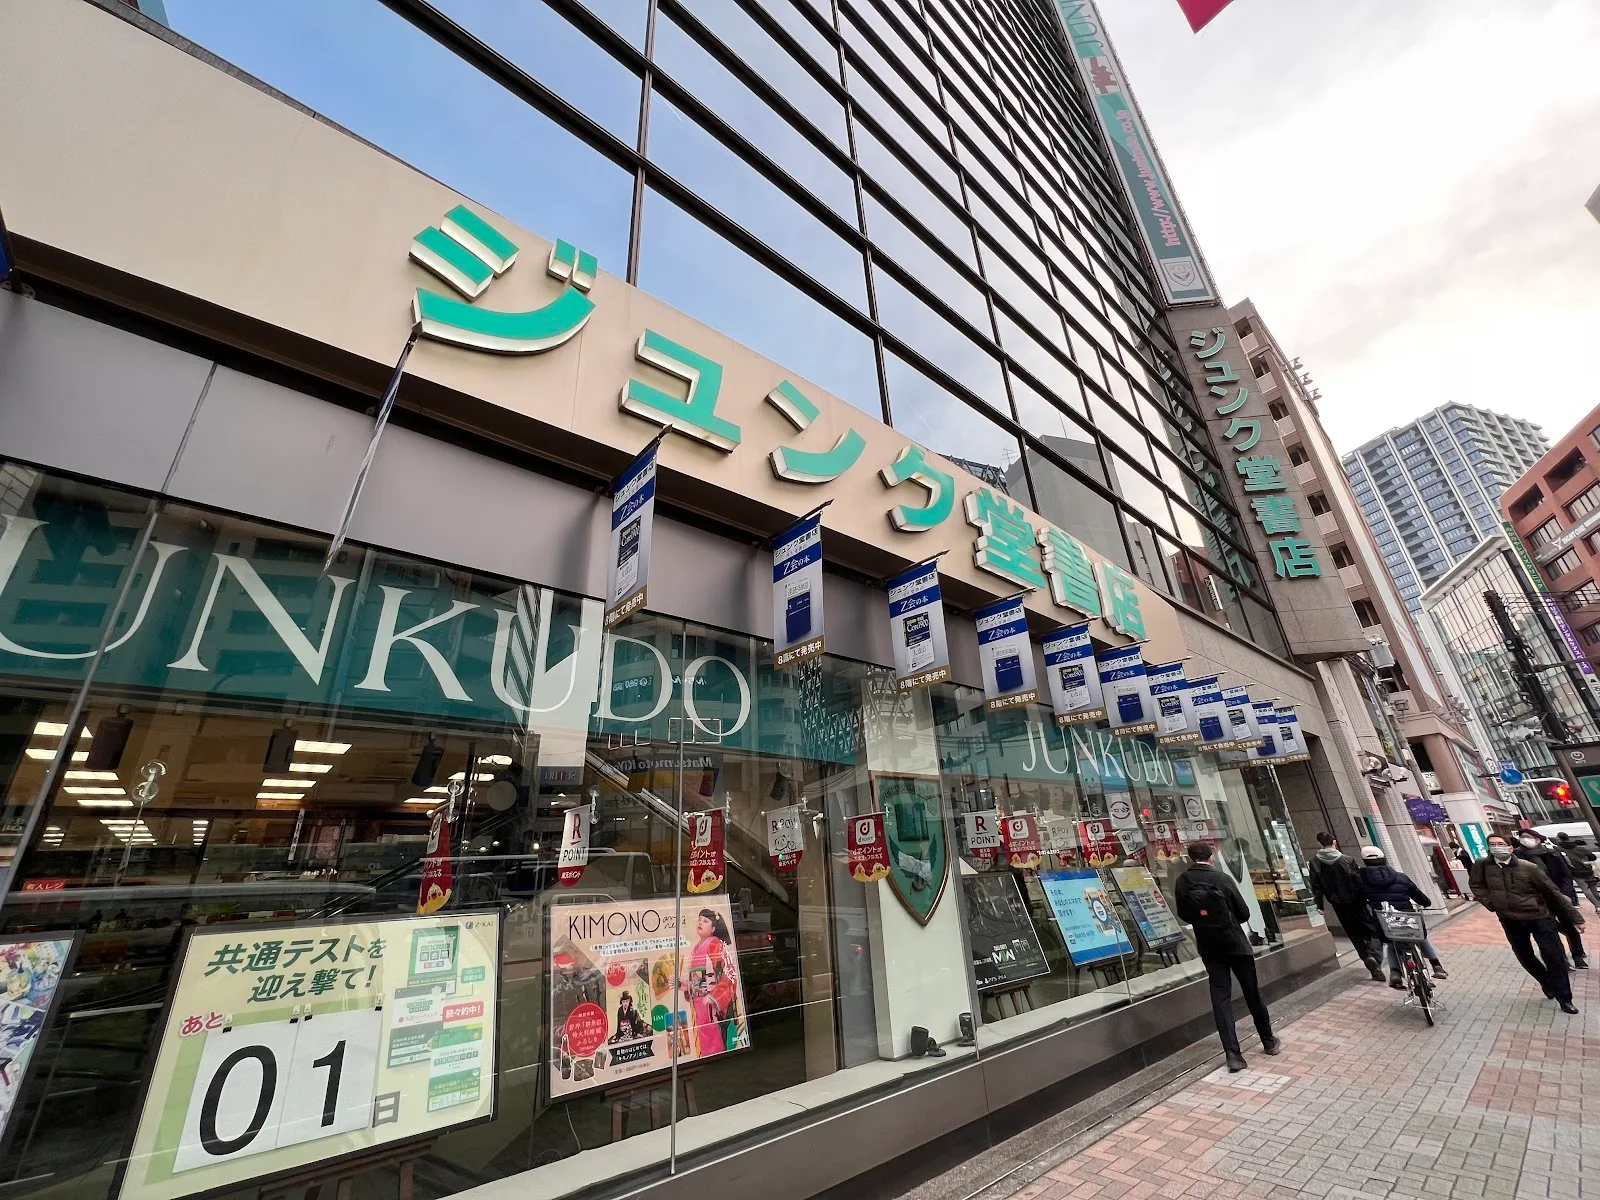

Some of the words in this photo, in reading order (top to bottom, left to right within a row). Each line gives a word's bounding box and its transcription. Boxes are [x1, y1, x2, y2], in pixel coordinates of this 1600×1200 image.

[408, 204, 1147, 642] ジュンク堂書店
[1190, 327, 1322, 579] ジュンク堂書店
[620, 493, 645, 522] Z会の本
[774, 529, 818, 558] ジュンク堂書店
[783, 554, 811, 576] Z会の本
[890, 573, 936, 597] ジュンク堂書店
[900, 595, 929, 613] Z会の本
[977, 608, 1023, 626] ジュンク堂書店
[988, 626, 1016, 641] Z会の本
[1044, 633, 1088, 650] ジュンク堂書店
[777, 640, 822, 665] 8階にて発売中
[1055, 650, 1082, 663] Z会の本
[1099, 654, 1140, 668] ジュンク堂書店
[900, 669, 947, 690] 8階にて発売中
[1109, 669, 1135, 680] Z会の本
[1153, 684, 1178, 694] Z会の本
[990, 693, 1036, 709] 8階にて発売中
[1058, 710, 1102, 724] 8階にて発売中
[1114, 723, 1155, 735] 8階にて発売中
[1159, 733, 1199, 744] 8階にて発売中
[1022, 720, 1174, 787] JUNKUDO
[572, 813, 582, 839] R
[975, 815, 988, 832] R
[970, 835, 996, 845] POINT
[562, 847, 587, 862] POINT
[569, 909, 660, 941] KIMONO
[204, 934, 387, 978] 共通テストを
[445, 1005, 482, 1019] 続々的中!
[181, 1011, 223, 1035] あと
[372, 1090, 402, 1129] 日
